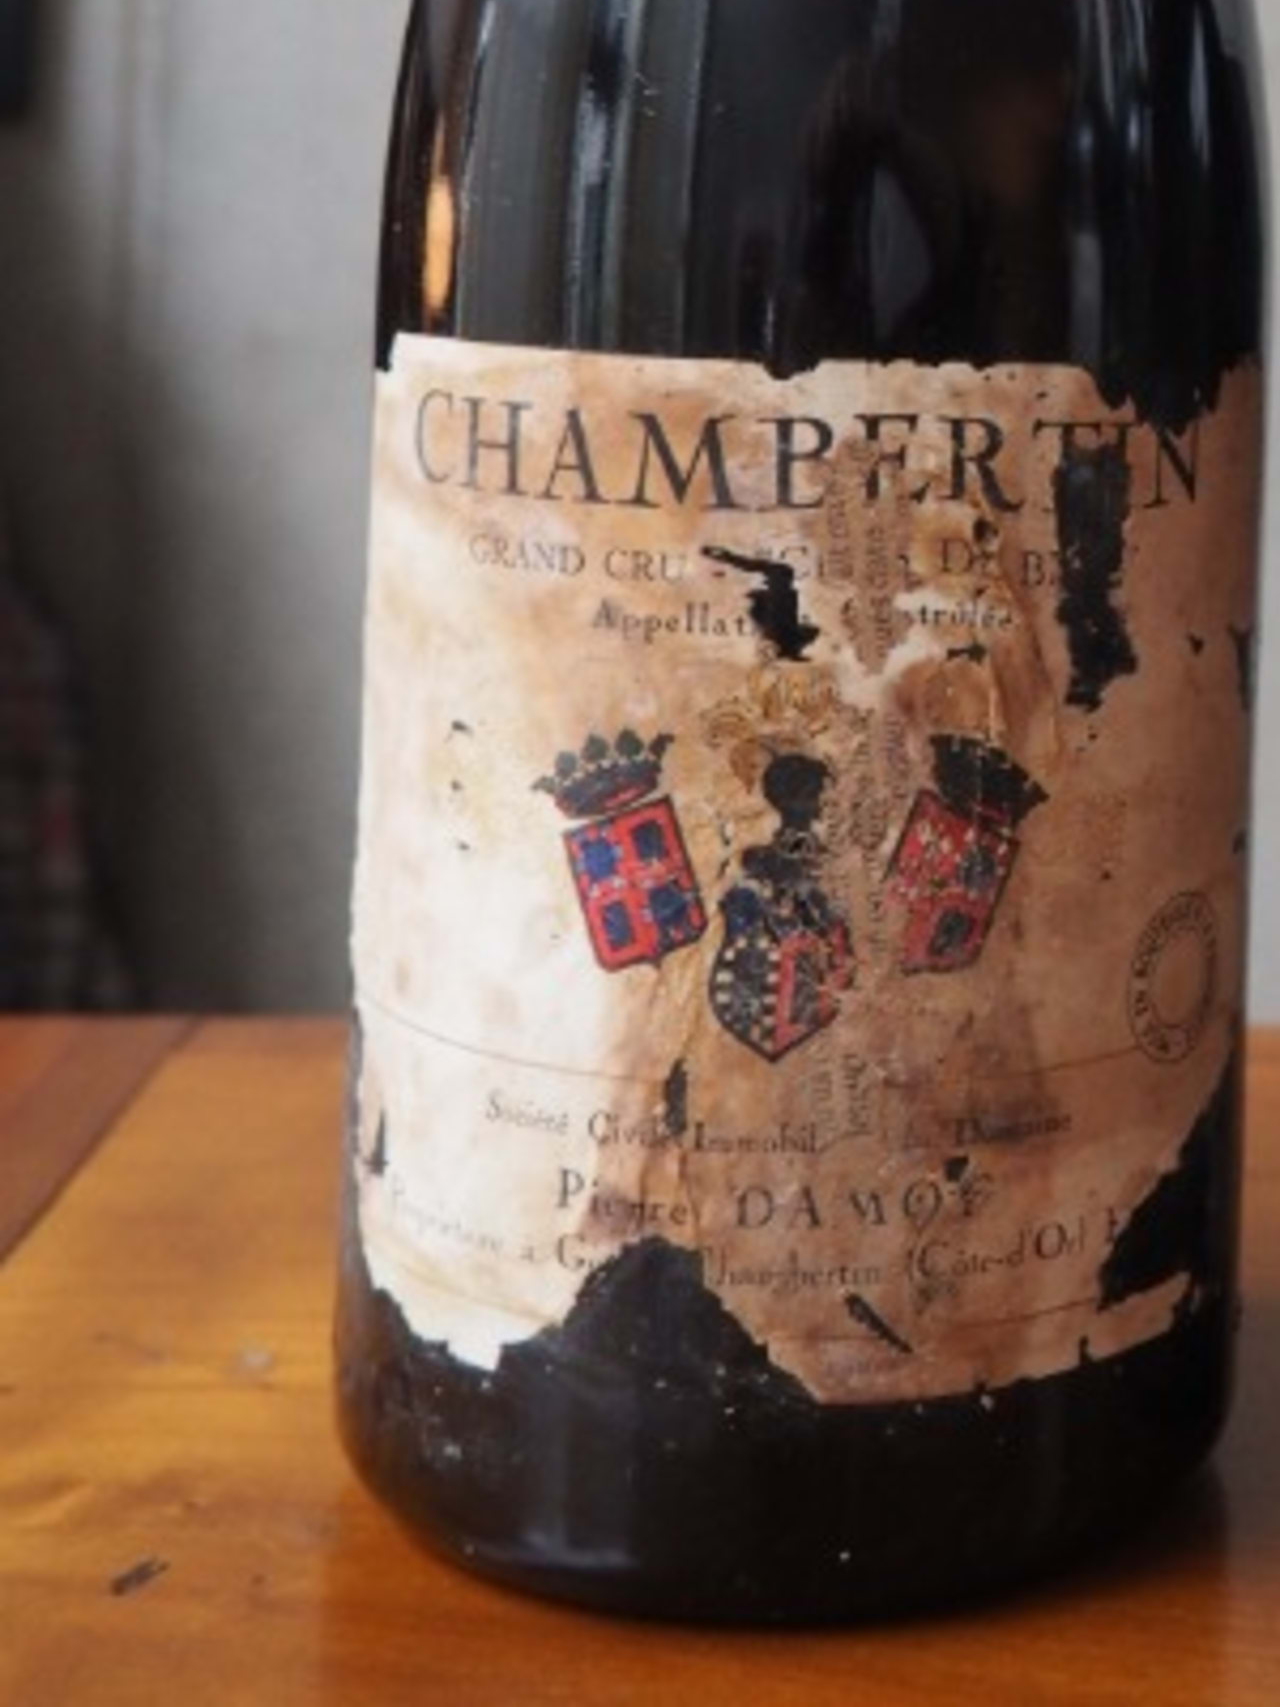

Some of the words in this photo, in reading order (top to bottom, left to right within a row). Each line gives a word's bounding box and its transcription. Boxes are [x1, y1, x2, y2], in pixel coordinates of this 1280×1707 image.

[467, 533, 587, 576] GRAND
[603, 547, 686, 584] CRU
[591, 596, 812, 645] Appellat
